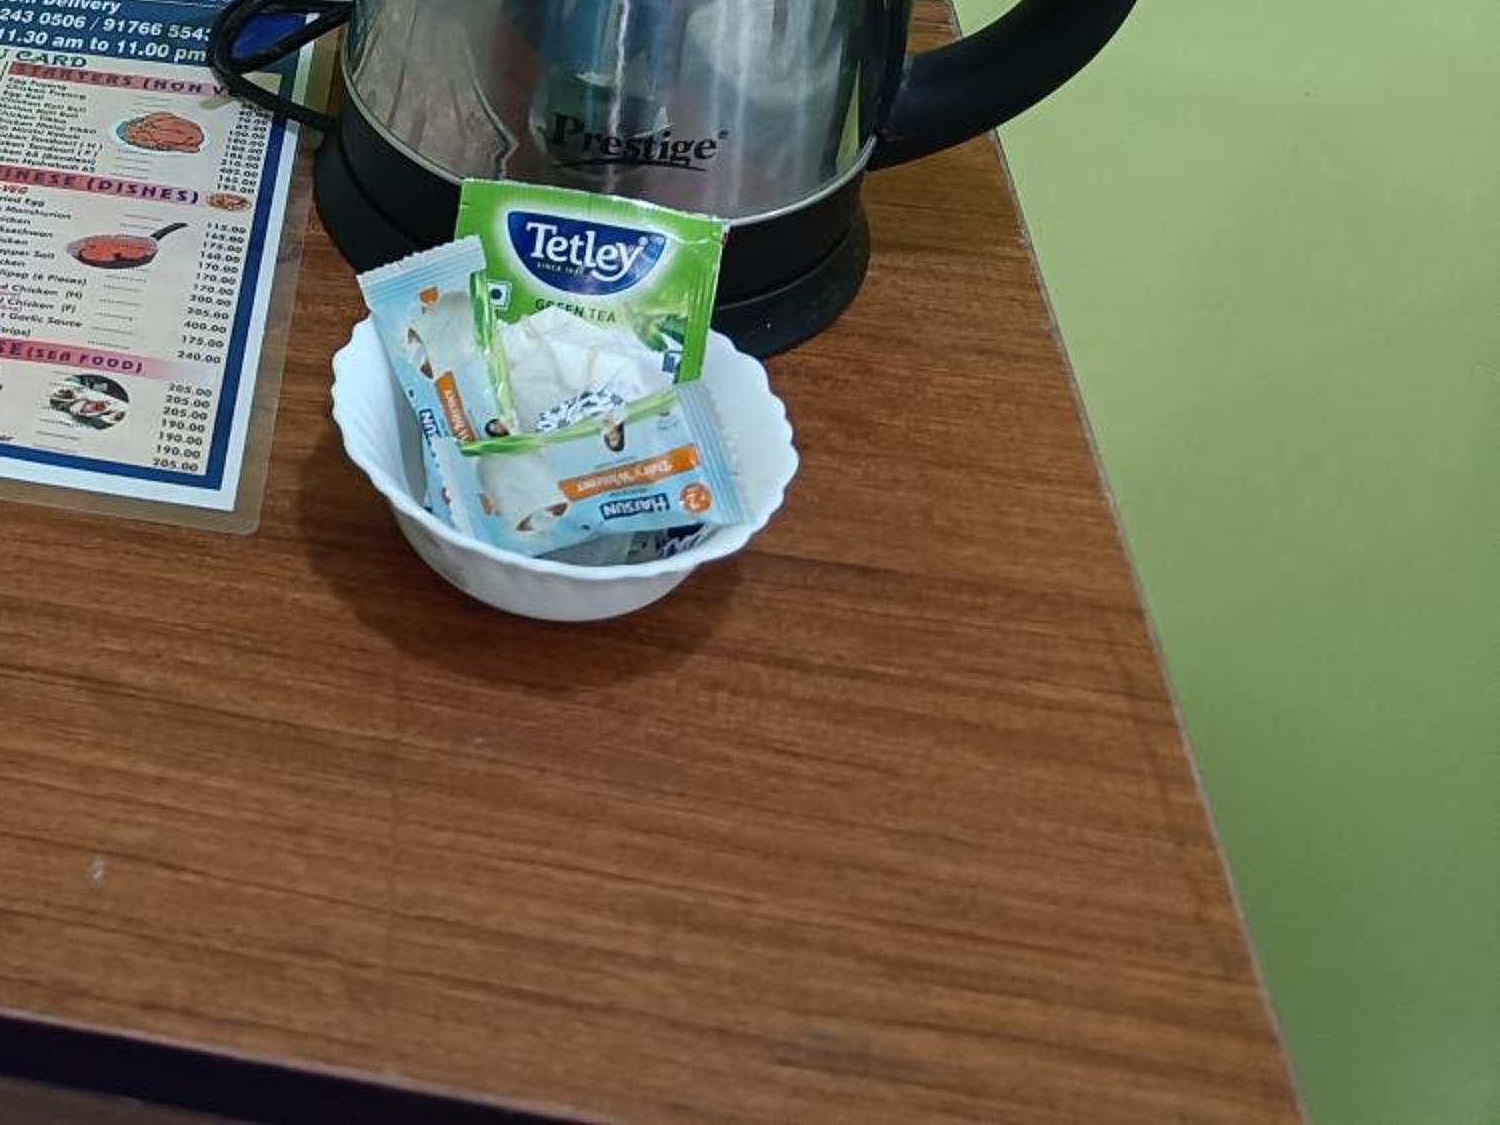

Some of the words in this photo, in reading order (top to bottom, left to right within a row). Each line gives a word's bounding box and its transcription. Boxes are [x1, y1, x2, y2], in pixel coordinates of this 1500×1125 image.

[39, 11, 87, 28] 0506
[103, 17, 162, 35] 91766
[54, 35, 83, 47] am
[90, 37, 109, 50] to
[117, 39, 169, 56] 11.00
[174, 48, 206, 64] pm
[15, 50, 87, 67] CARD
[553, 112, 718, 167] Prestige
[87, 178, 199, 203] (DISHES)
[526, 222, 645, 281] Tetley
[12, 284, 57, 296] Chicken
[7, 298, 53, 310] Chicken
[184, 321, 226, 333] 400.00
[48, 317, 82, 327] Sauce
[588, 307, 616, 323] TEA
[80, 355, 142, 371] FOOD)
[177, 350, 220, 363] 240.00
[169, 383, 212, 396] 205.00
[166, 395, 209, 408] 205.00
[164, 406, 207, 420] 205.00
[162, 418, 205, 433] 190.00
[159, 431, 202, 445] 190.00
[156, 444, 200, 458] 190.00
[153, 457, 197, 471] 205.00
